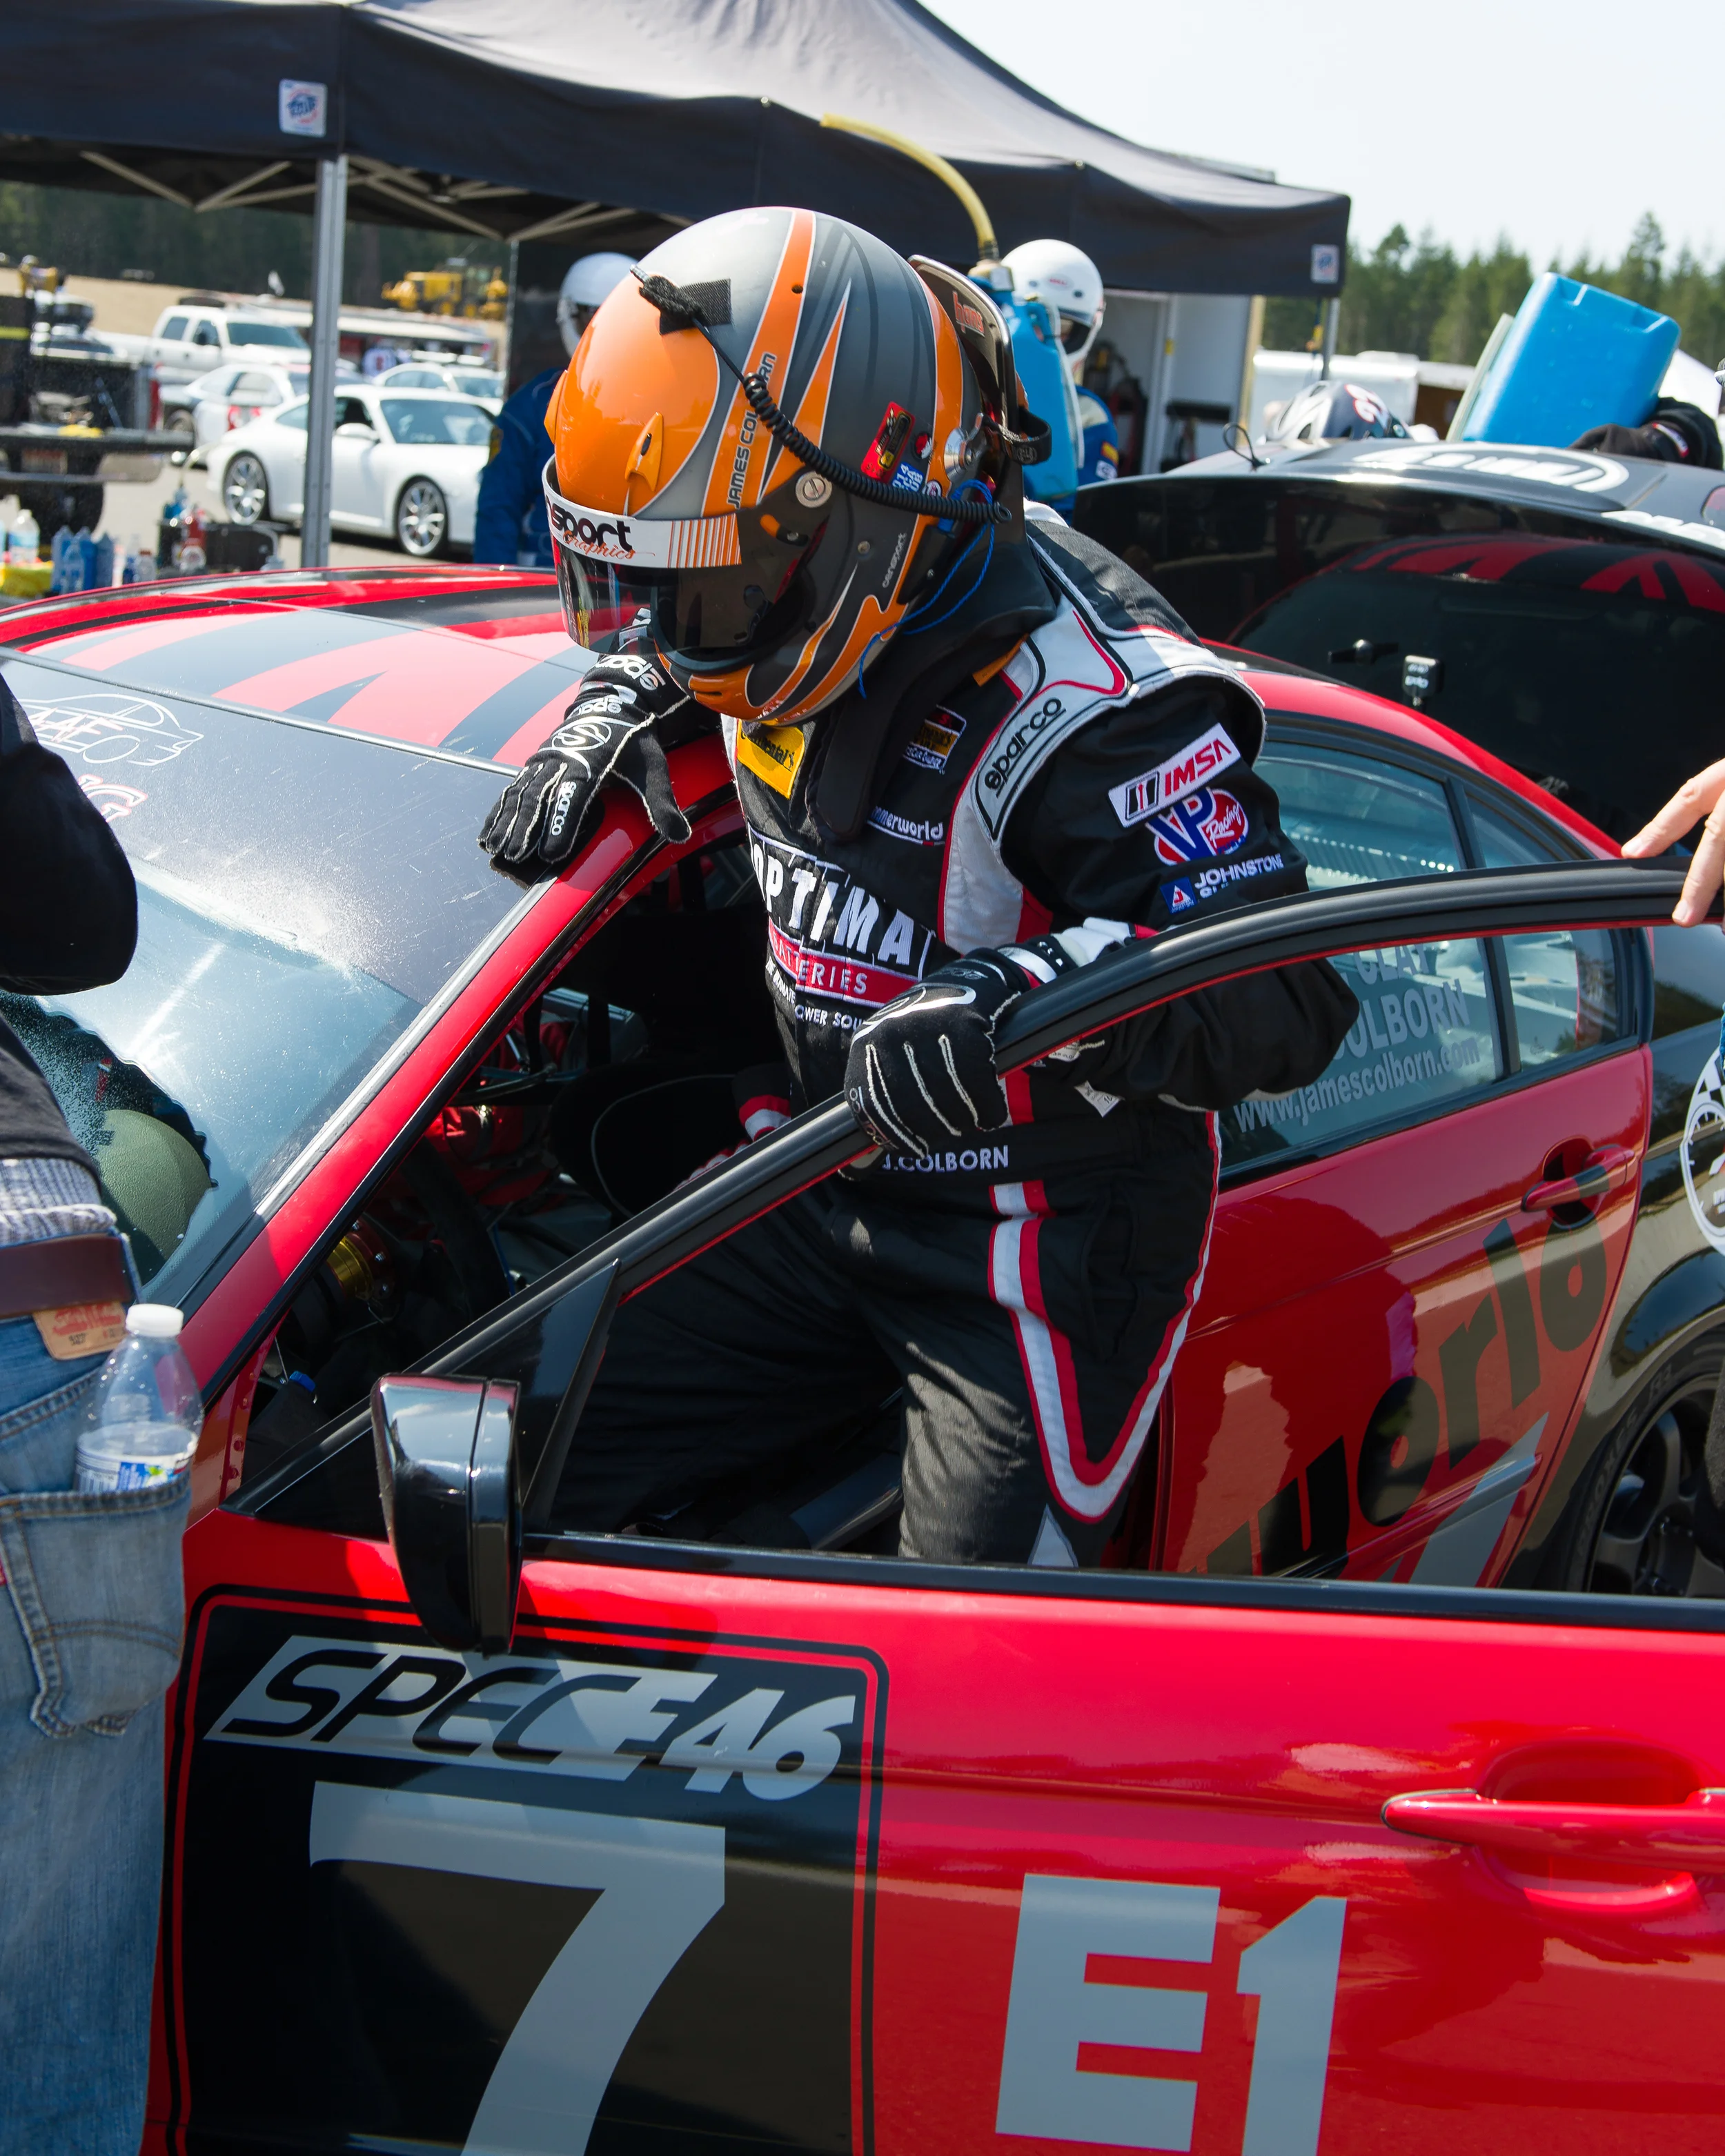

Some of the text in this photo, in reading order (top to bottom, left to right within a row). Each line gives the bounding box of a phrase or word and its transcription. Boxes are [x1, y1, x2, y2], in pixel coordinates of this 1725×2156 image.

[727, 351, 778, 511] JAMES COLRN
[892, 463, 909, 488] 014
[562, 529, 638, 560] Graphics
[984, 697, 1063, 790] sparco
[1164, 739, 1232, 797] IMSA
[552, 780, 577, 836] sparco
[1146, 787, 1217, 862] VP
[1205, 802, 1243, 849] Racing
[1194, 853, 1285, 889] JOHNSTON
[772, 931, 868, 995] BATTERIES
[794, 1003, 828, 1027] OWER
[832, 1012, 863, 1031] SOU
[1333, 978, 1470, 1060] OLBORN
[1233, 1036, 1481, 1133] www.jamescolborn.com
[882, 1145, 1009, 1173] J.COLBORN
[309, 1781, 725, 2156] 7
[996, 1872, 1348, 2156] E1
